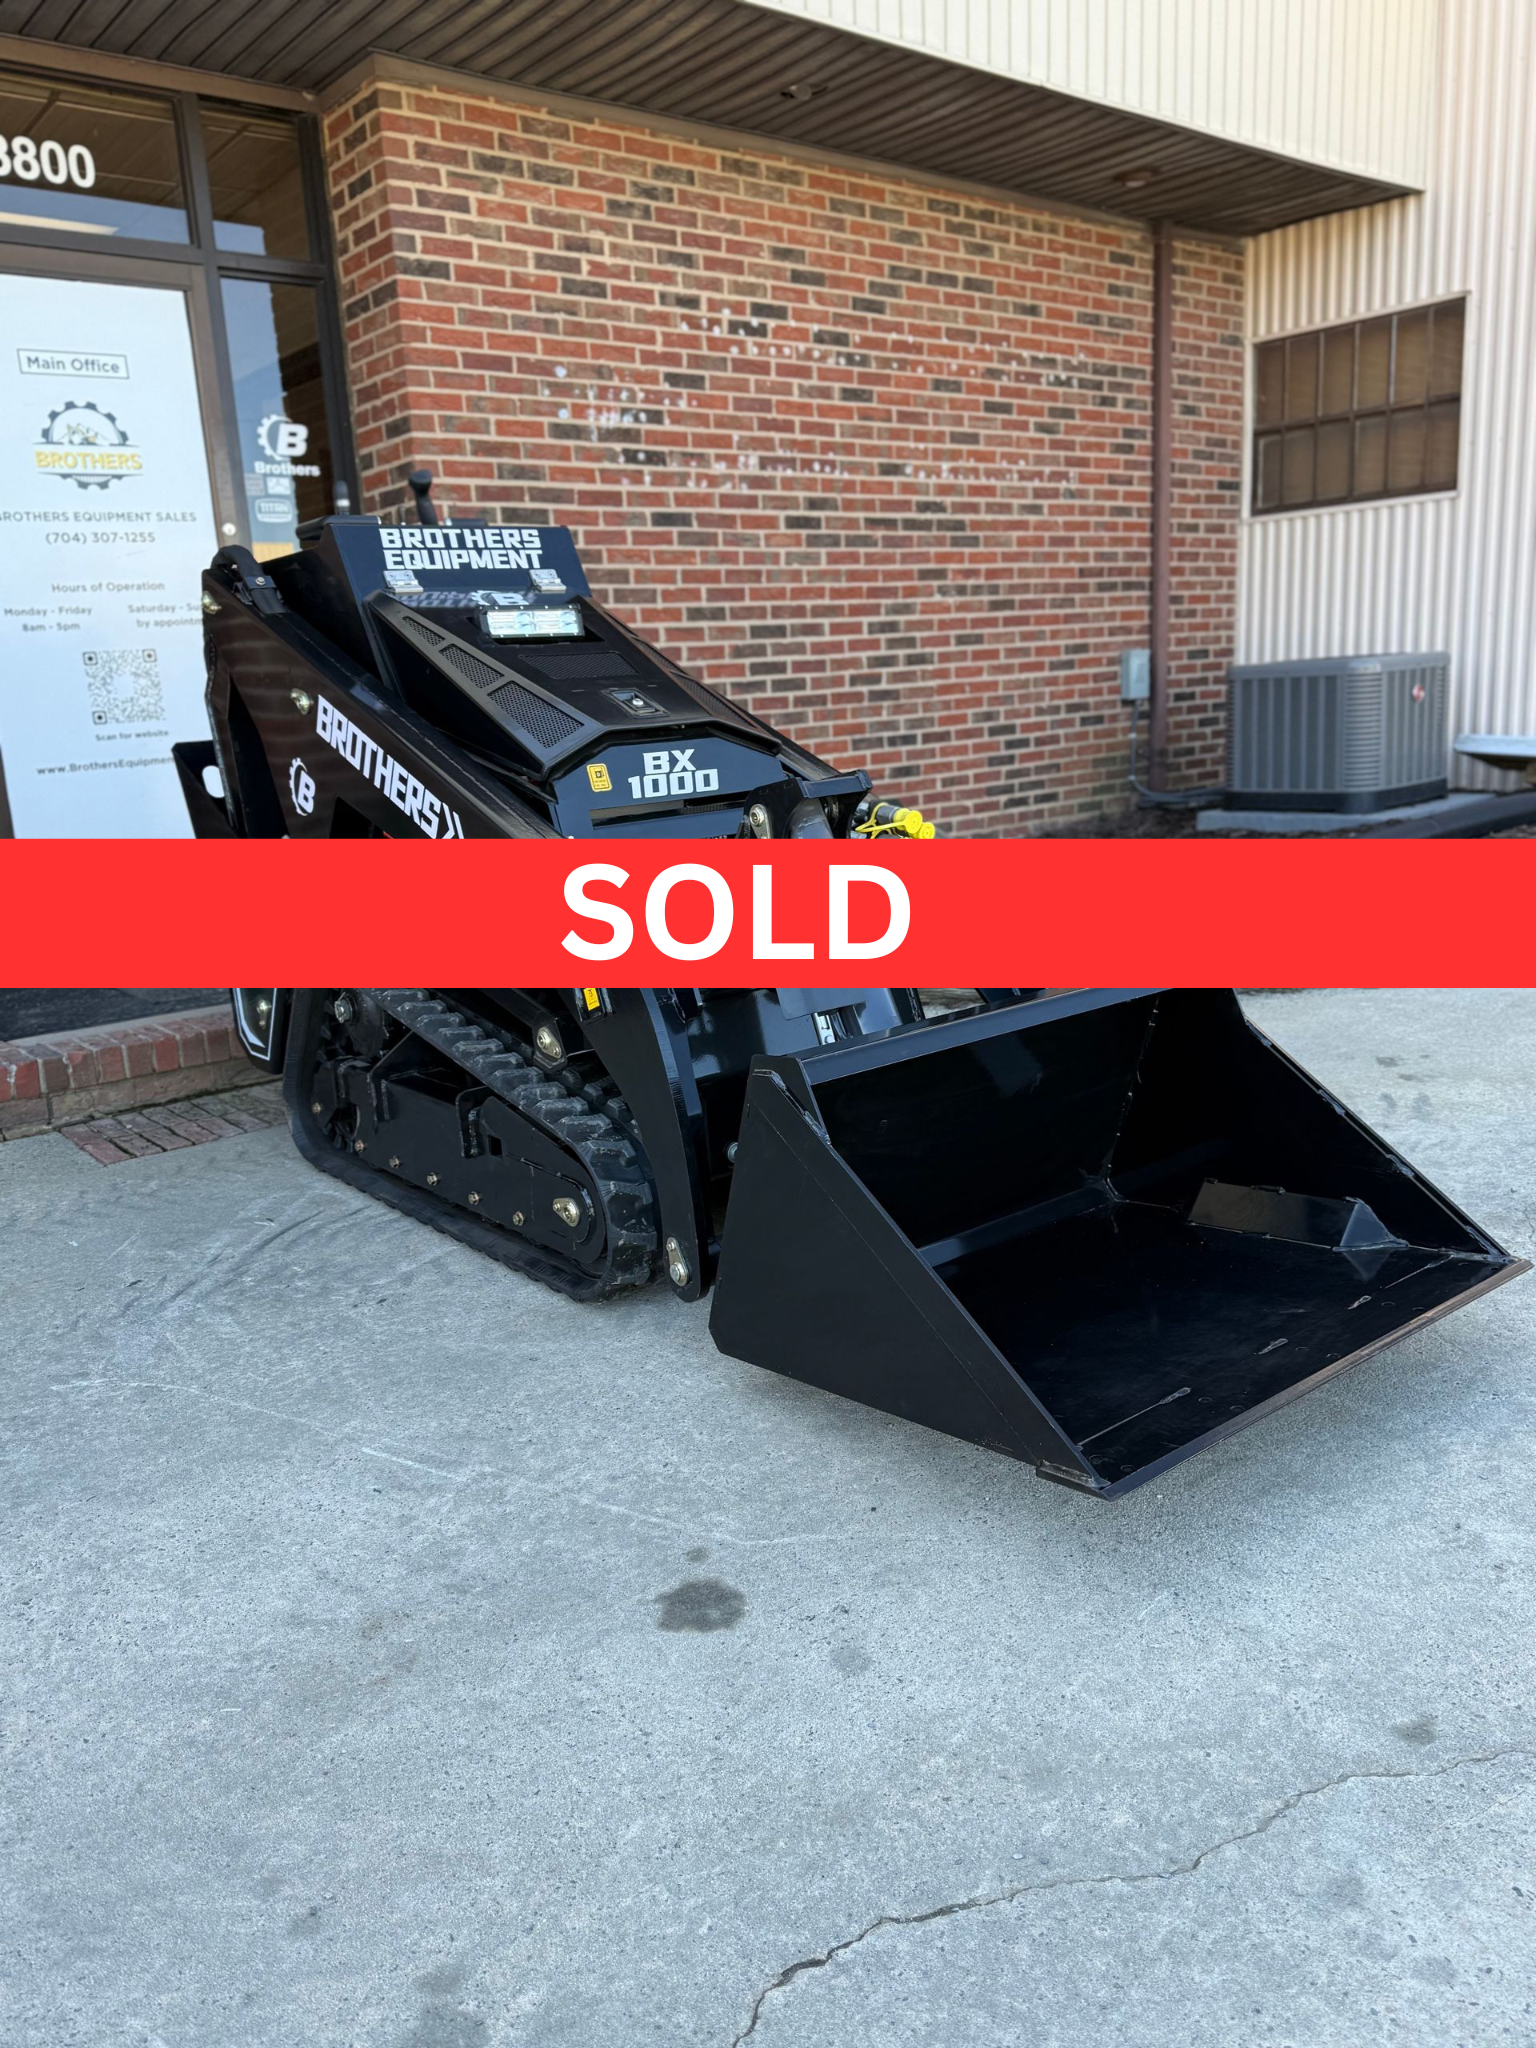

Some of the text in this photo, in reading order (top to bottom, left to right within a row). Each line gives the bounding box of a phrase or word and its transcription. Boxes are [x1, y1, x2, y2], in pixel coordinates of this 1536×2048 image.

[27, 355, 120, 373] Main Office
[35, 451, 142, 470] BROTHERS
[254, 461, 321, 477] Brothers
[73, 511, 151, 523] EQUIPMENT
[156, 511, 197, 522] SALES
[46, 532, 156, 544] (704) 307-1255
[379, 528, 541, 548] BROTHERS
[384, 550, 543, 569] EQUIPMENT
[52, 581, 165, 593] Hours of Operation
[4, 608, 48, 617] Monday
[58, 606, 92, 616] Friday
[128, 603, 176, 614] Saturday
[22, 624, 46, 632] 8am
[56, 621, 81, 632] 5pm
[137, 617, 203, 629] by appointm
[36, 757, 175, 775] www.BrothersEquipmen
[316, 694, 441, 839] BROTHERS
[643, 749, 696, 775] BX
[628, 769, 719, 799] 1000
